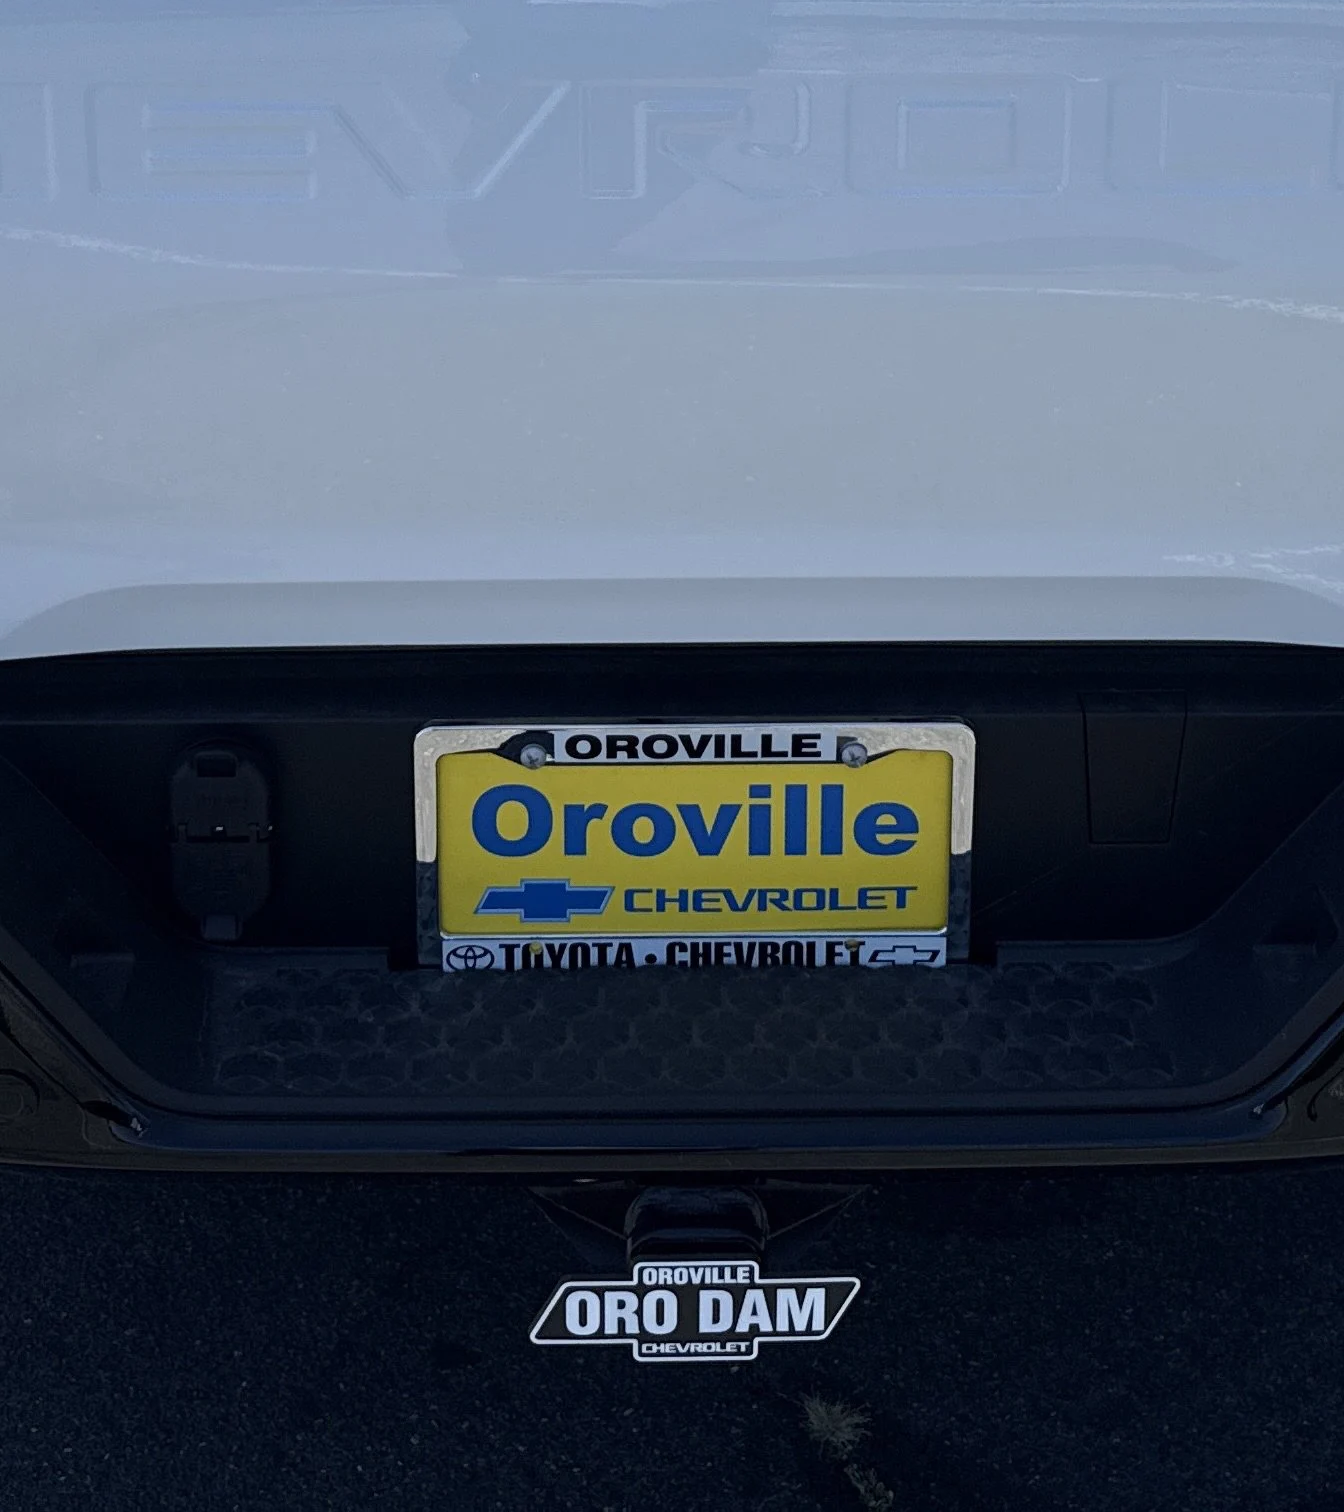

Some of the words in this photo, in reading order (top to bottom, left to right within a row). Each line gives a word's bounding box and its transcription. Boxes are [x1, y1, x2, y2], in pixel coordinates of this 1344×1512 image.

[564, 733, 823, 760] OROVILLE
[471, 783, 920, 858] Oroville
[623, 885, 919, 914] CHEVROLET
[498, 941, 636, 973] TOYOTA
[665, 940, 867, 969] CHEVROLET
[642, 1266, 751, 1285] OROVILLE
[565, 1289, 680, 1336] ORO
[698, 1288, 827, 1333] DAM
[640, 1341, 750, 1355] CHEVROLET
